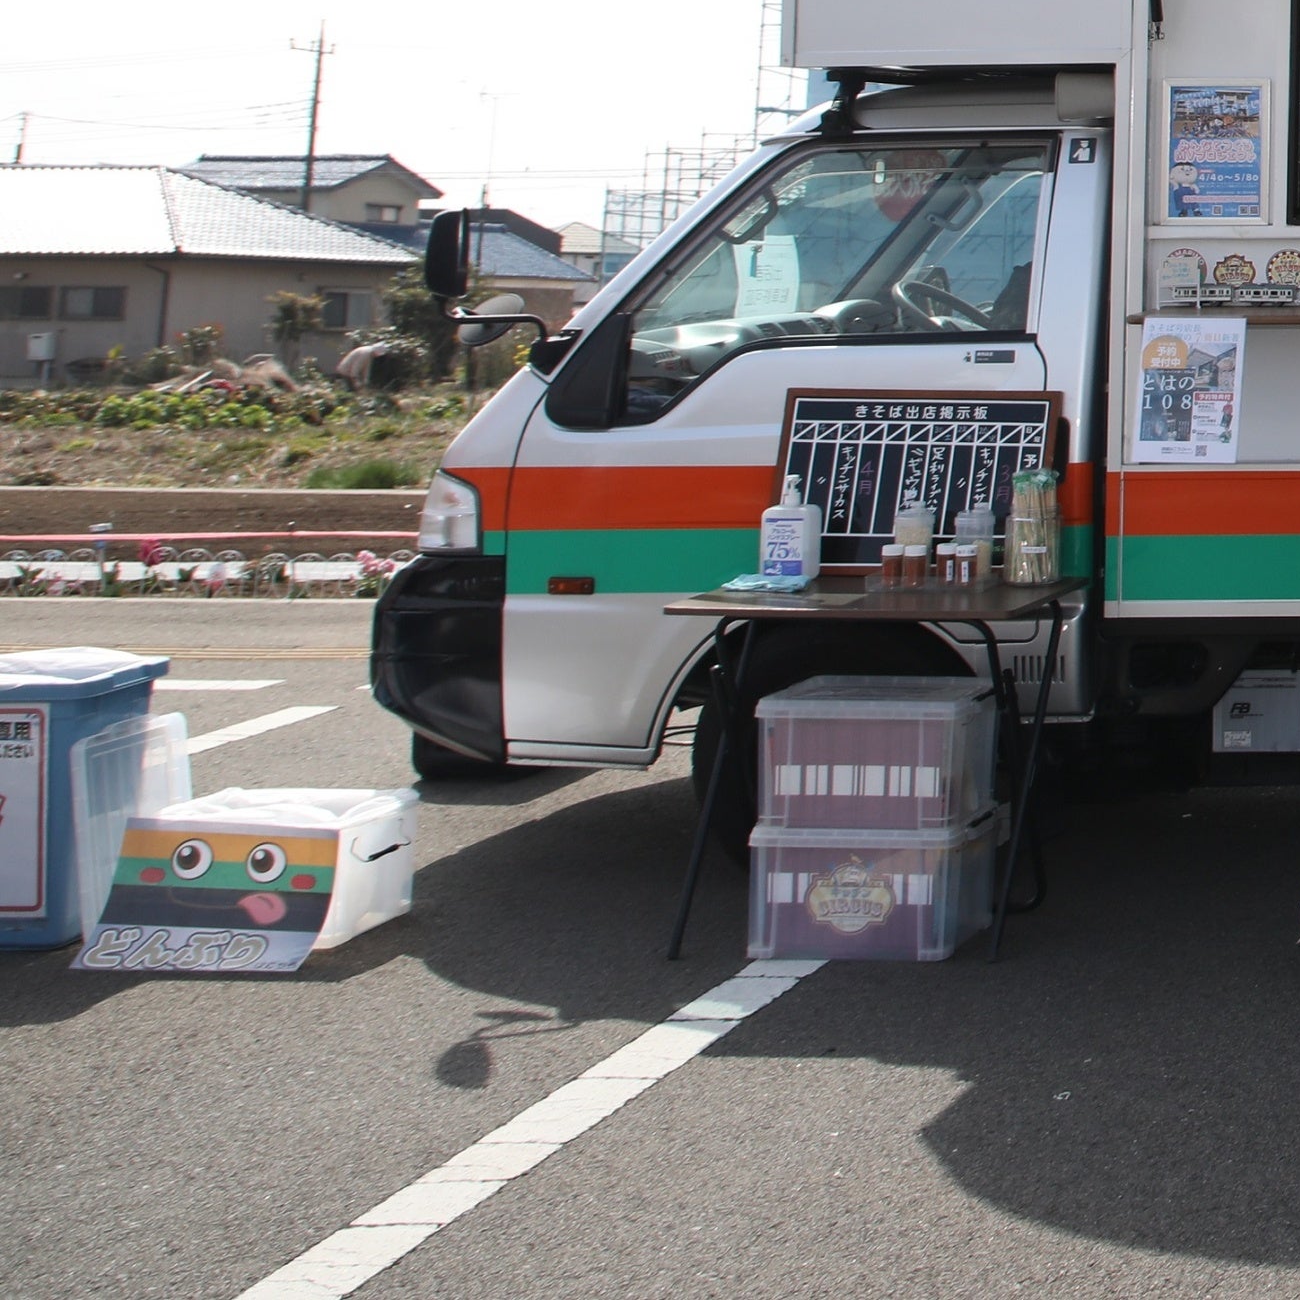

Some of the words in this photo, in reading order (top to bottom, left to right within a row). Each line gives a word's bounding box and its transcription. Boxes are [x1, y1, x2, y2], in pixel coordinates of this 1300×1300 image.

[1143, 374, 1196, 391] とはの
[1143, 394, 1192, 410] 108
[855, 405, 989, 419] きそば出店掲示板
[832, 446, 856, 519] キッチンサーカス
[767, 541, 800, 559] 75%
[83, 927, 268, 969] どんぶり
